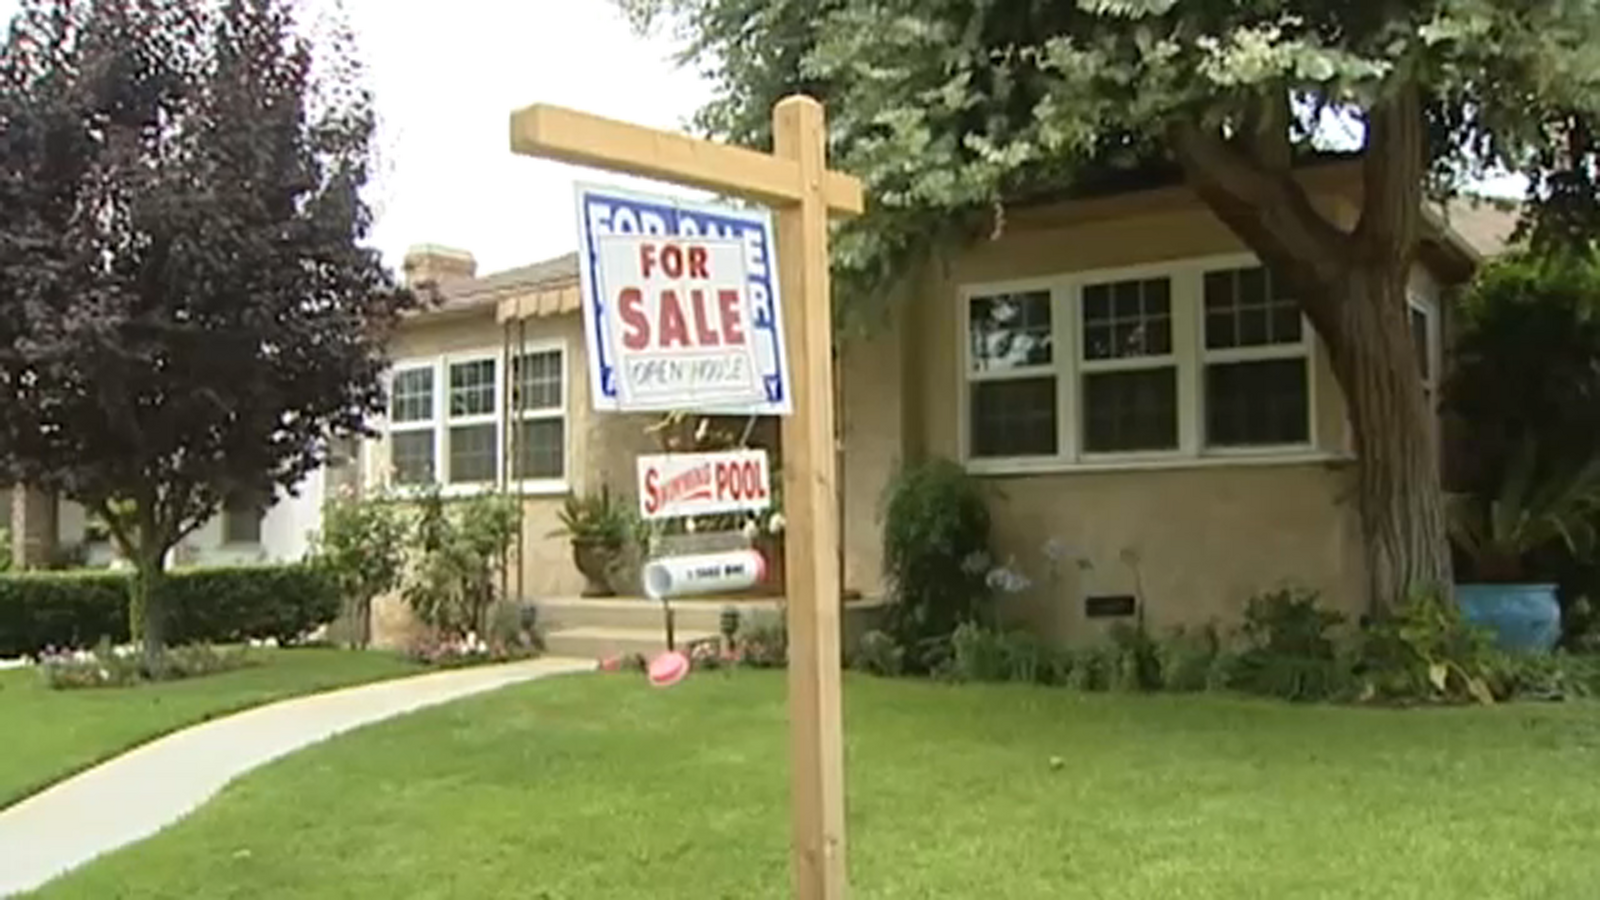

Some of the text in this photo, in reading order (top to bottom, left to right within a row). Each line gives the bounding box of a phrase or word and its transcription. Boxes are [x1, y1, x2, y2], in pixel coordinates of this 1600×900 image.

[640, 244, 709, 279] FOR
[618, 288, 745, 350] SALE
[634, 359, 683, 384] OPEN
[715, 461, 766, 500] POOL
